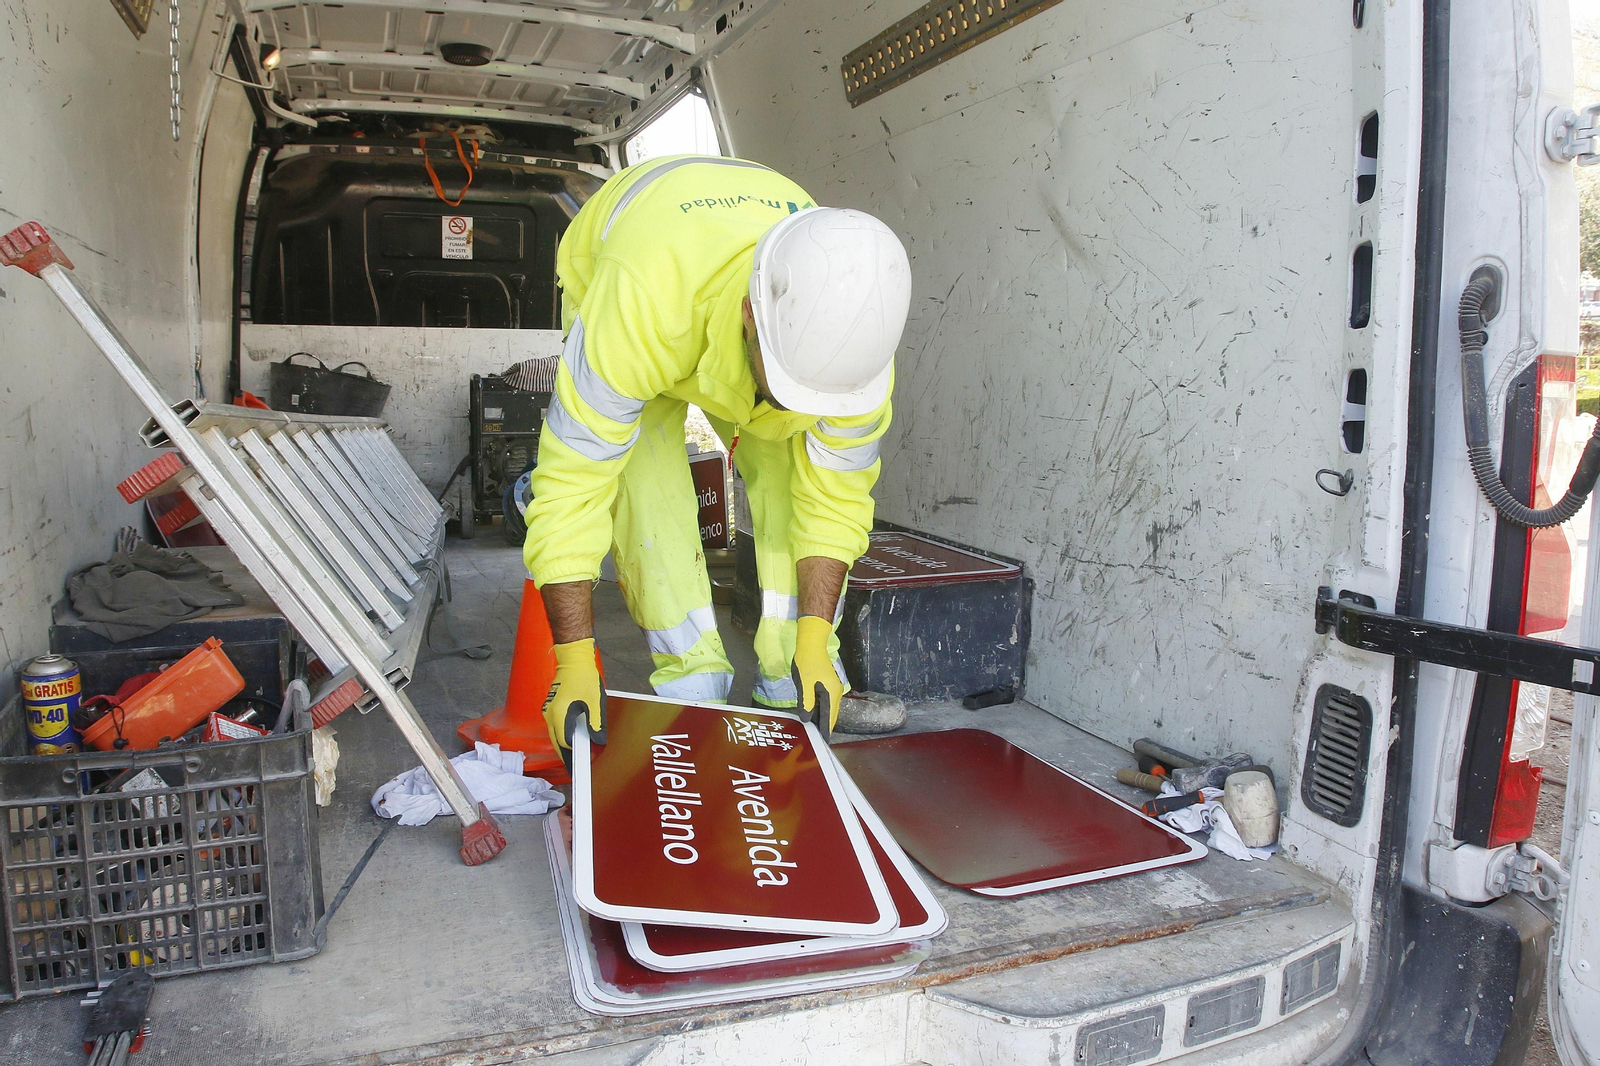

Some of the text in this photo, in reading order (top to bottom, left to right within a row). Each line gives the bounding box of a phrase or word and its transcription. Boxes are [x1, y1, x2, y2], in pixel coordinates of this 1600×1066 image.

[680, 195, 781, 214] movilidad
[874, 546, 947, 569] Avenida
[34, 680, 74, 698] GRATIS
[650, 733, 703, 865] Vallellano
[727, 764, 798, 888] Avenida
